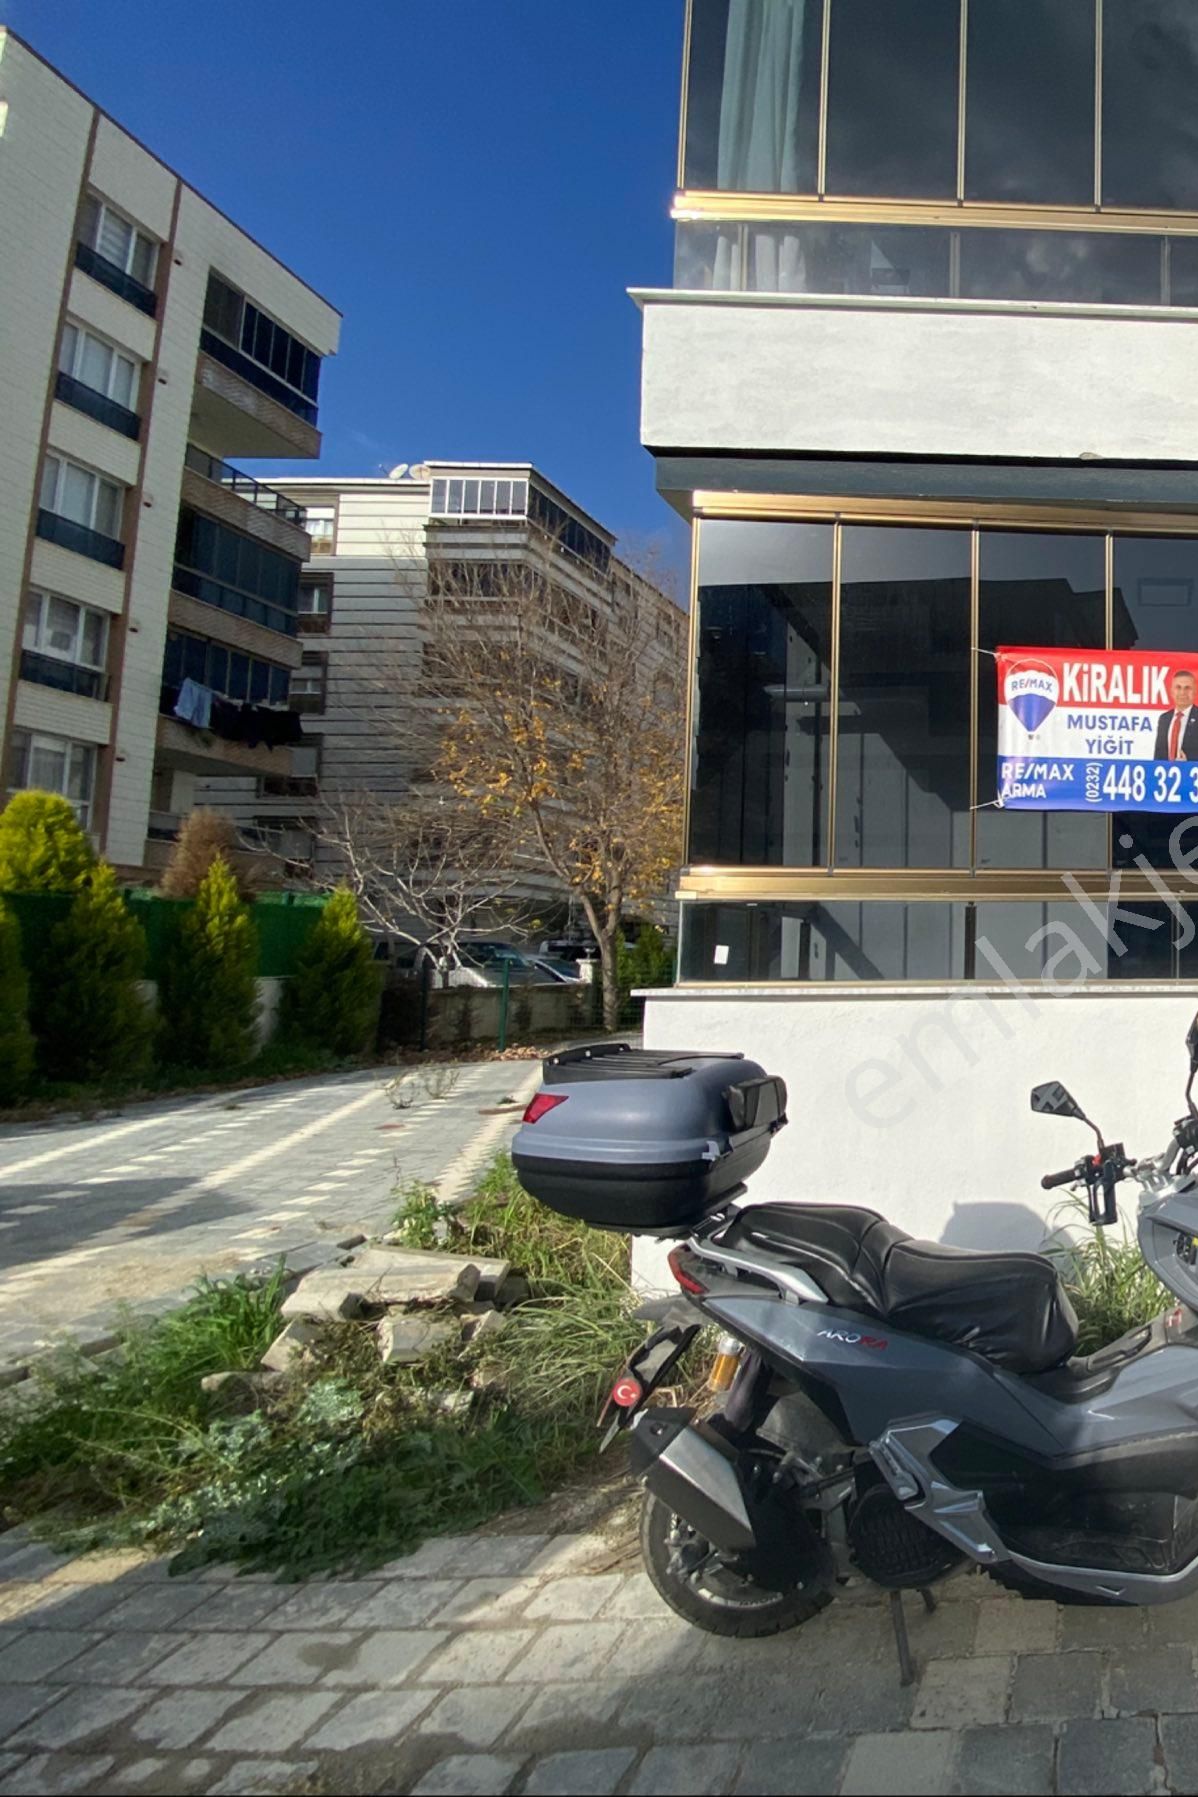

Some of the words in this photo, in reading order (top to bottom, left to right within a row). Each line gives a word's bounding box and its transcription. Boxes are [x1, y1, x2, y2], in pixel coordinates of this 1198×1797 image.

[1011, 677, 1054, 693] RE/MAX
[1067, 714, 1153, 732] MUSTAFA
[1085, 735, 1135, 755] YİĞİT
[1001, 762, 1074, 781] RE/MAX
[1001, 782, 1047, 799] ARMA
[1085, 762, 1104, 803] (0232)
[1103, 764, 1147, 802] 448
[1153, 765, 1182, 803] 32
[816, 1329, 889, 1351] ARORA
